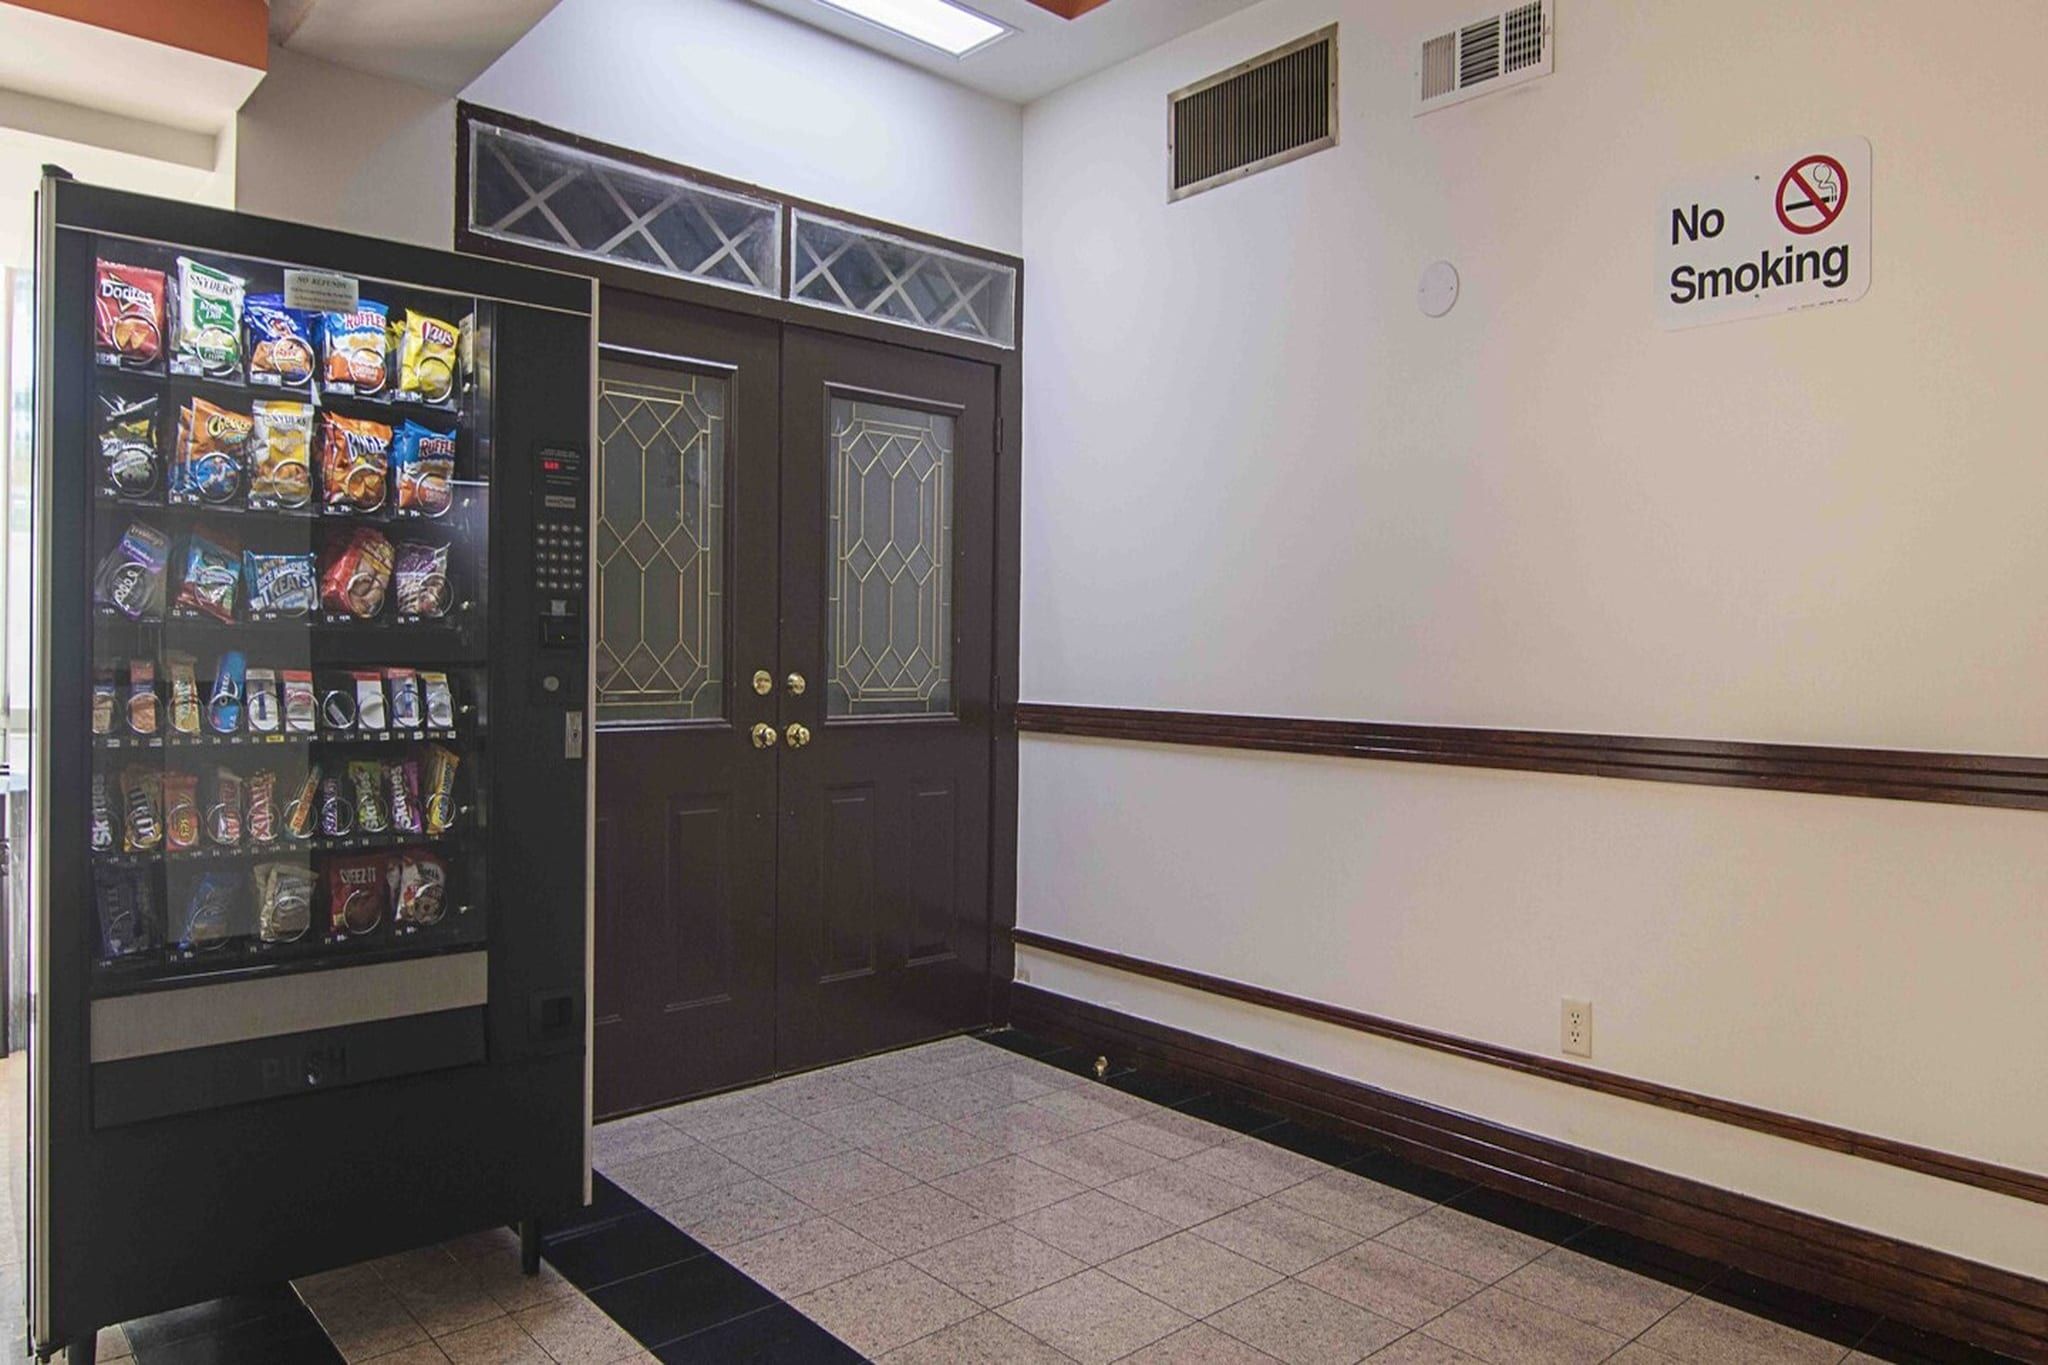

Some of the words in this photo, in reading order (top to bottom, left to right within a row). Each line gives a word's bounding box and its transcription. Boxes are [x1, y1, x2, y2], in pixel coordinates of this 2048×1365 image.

[1671, 204, 1725, 246] No
[101, 279, 153, 305] Doritos
[1669, 244, 1850, 305] Smoking
